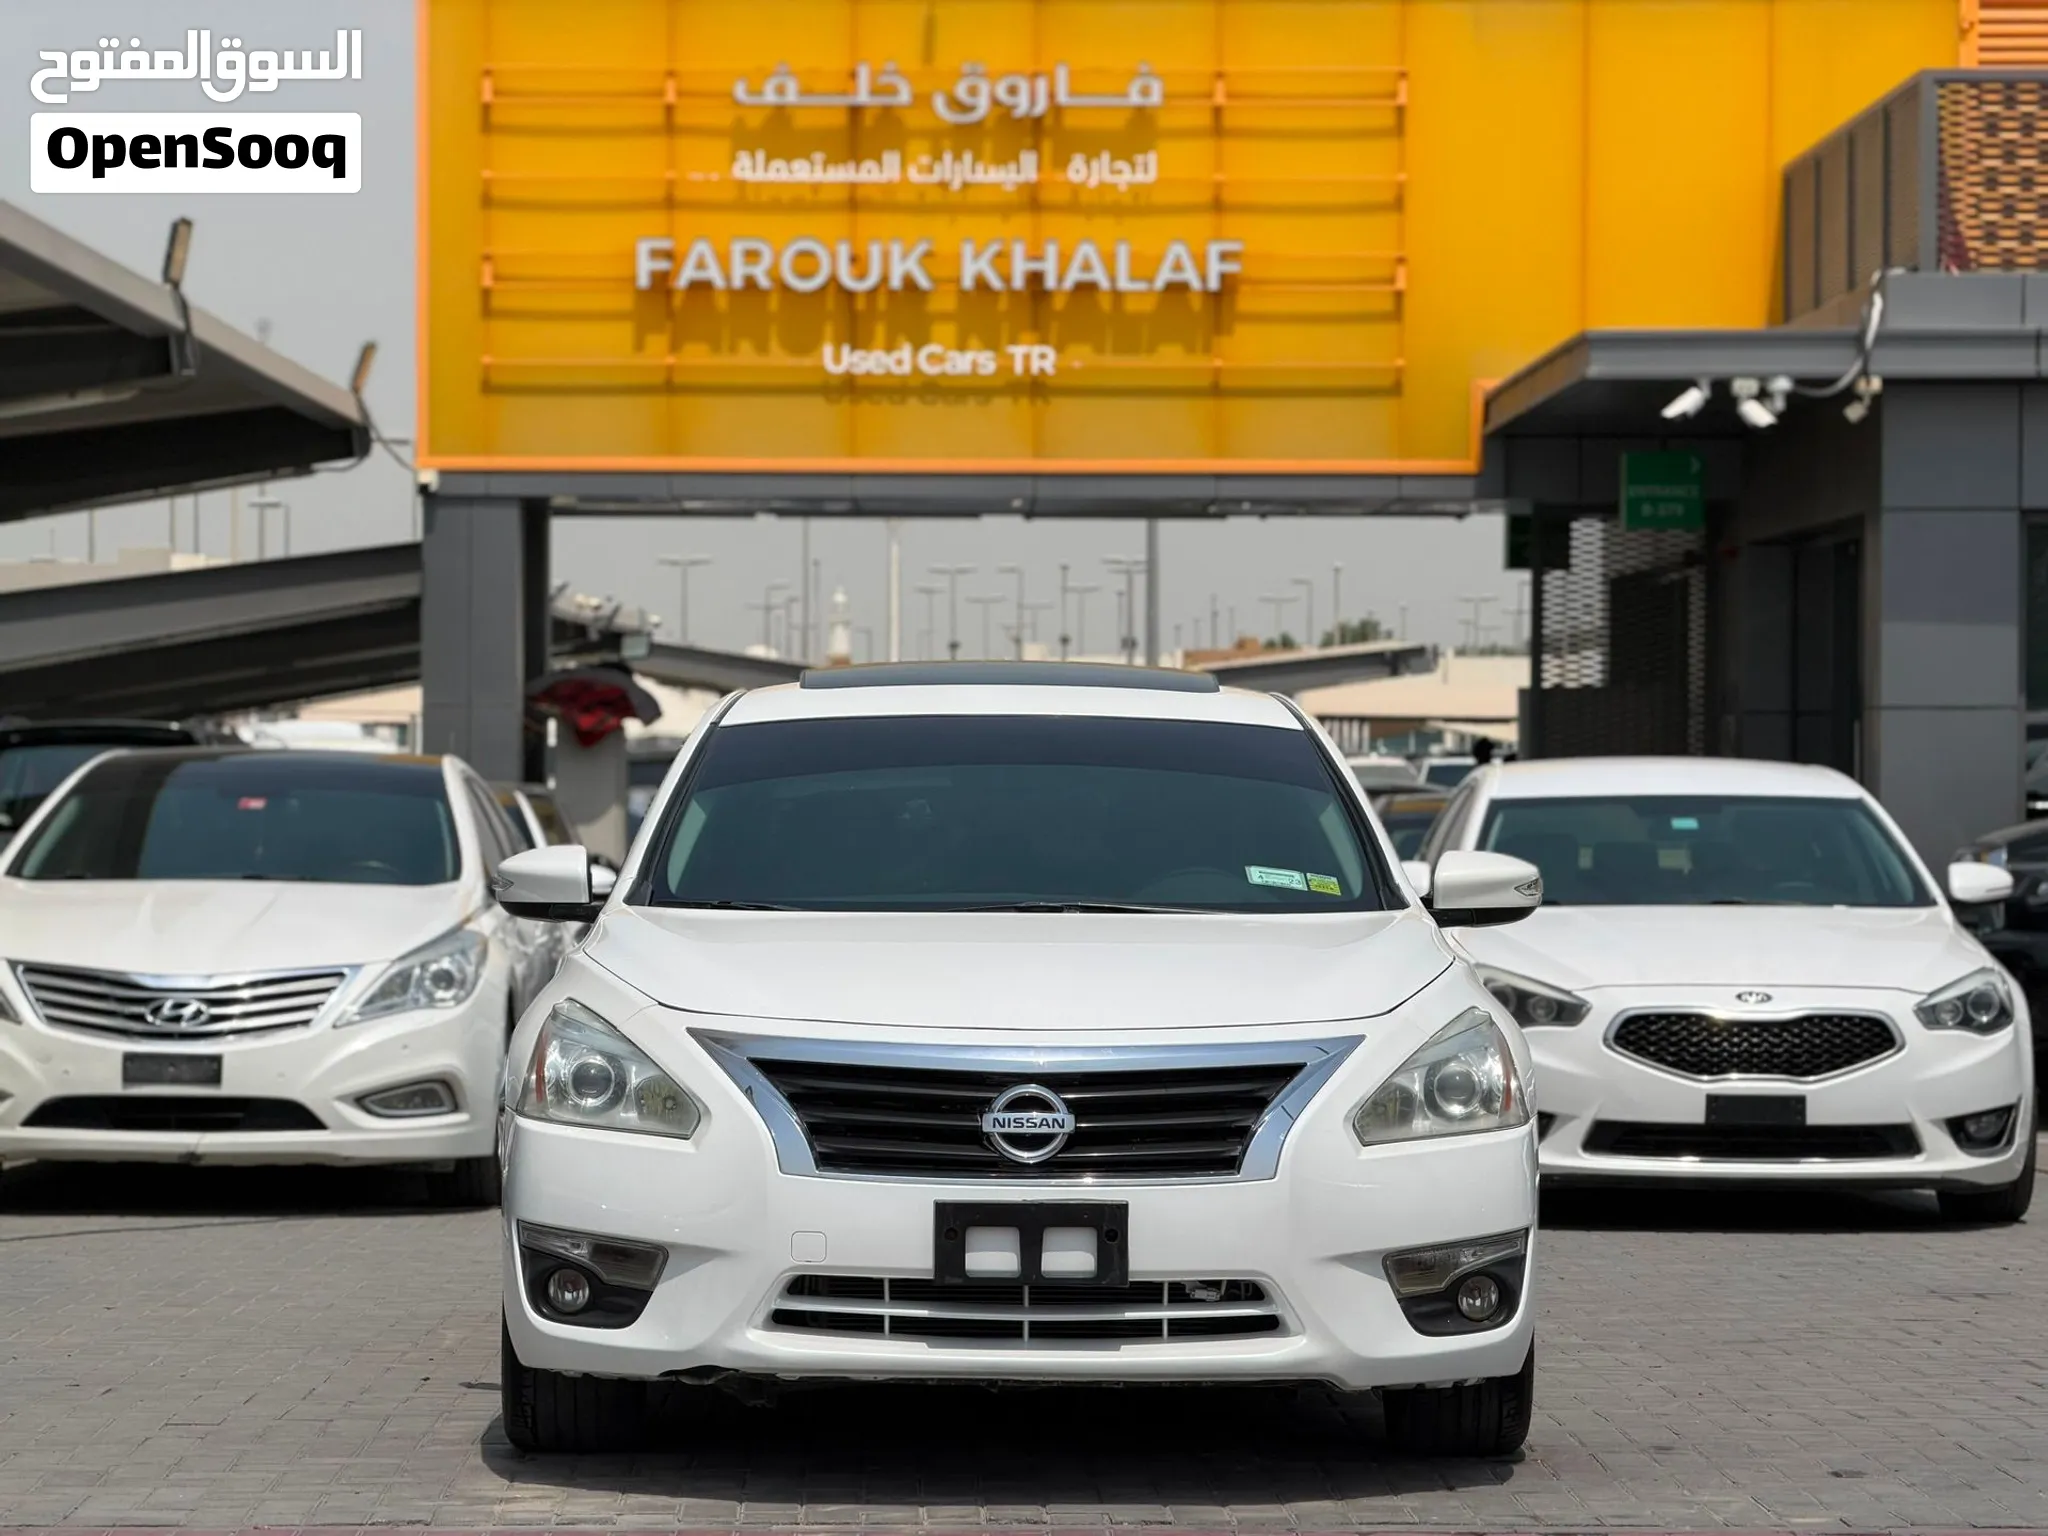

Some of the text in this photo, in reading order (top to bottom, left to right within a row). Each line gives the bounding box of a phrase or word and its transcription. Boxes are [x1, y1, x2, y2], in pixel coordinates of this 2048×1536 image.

[732, 148, 901, 183] المستعملة
[1066, 149, 1158, 192] لتجارة
[634, 237, 1244, 293] FAROUK KHALAF
[822, 343, 1058, 376] Used Cars TR
[992, 1117, 1065, 1129] NISSAN
